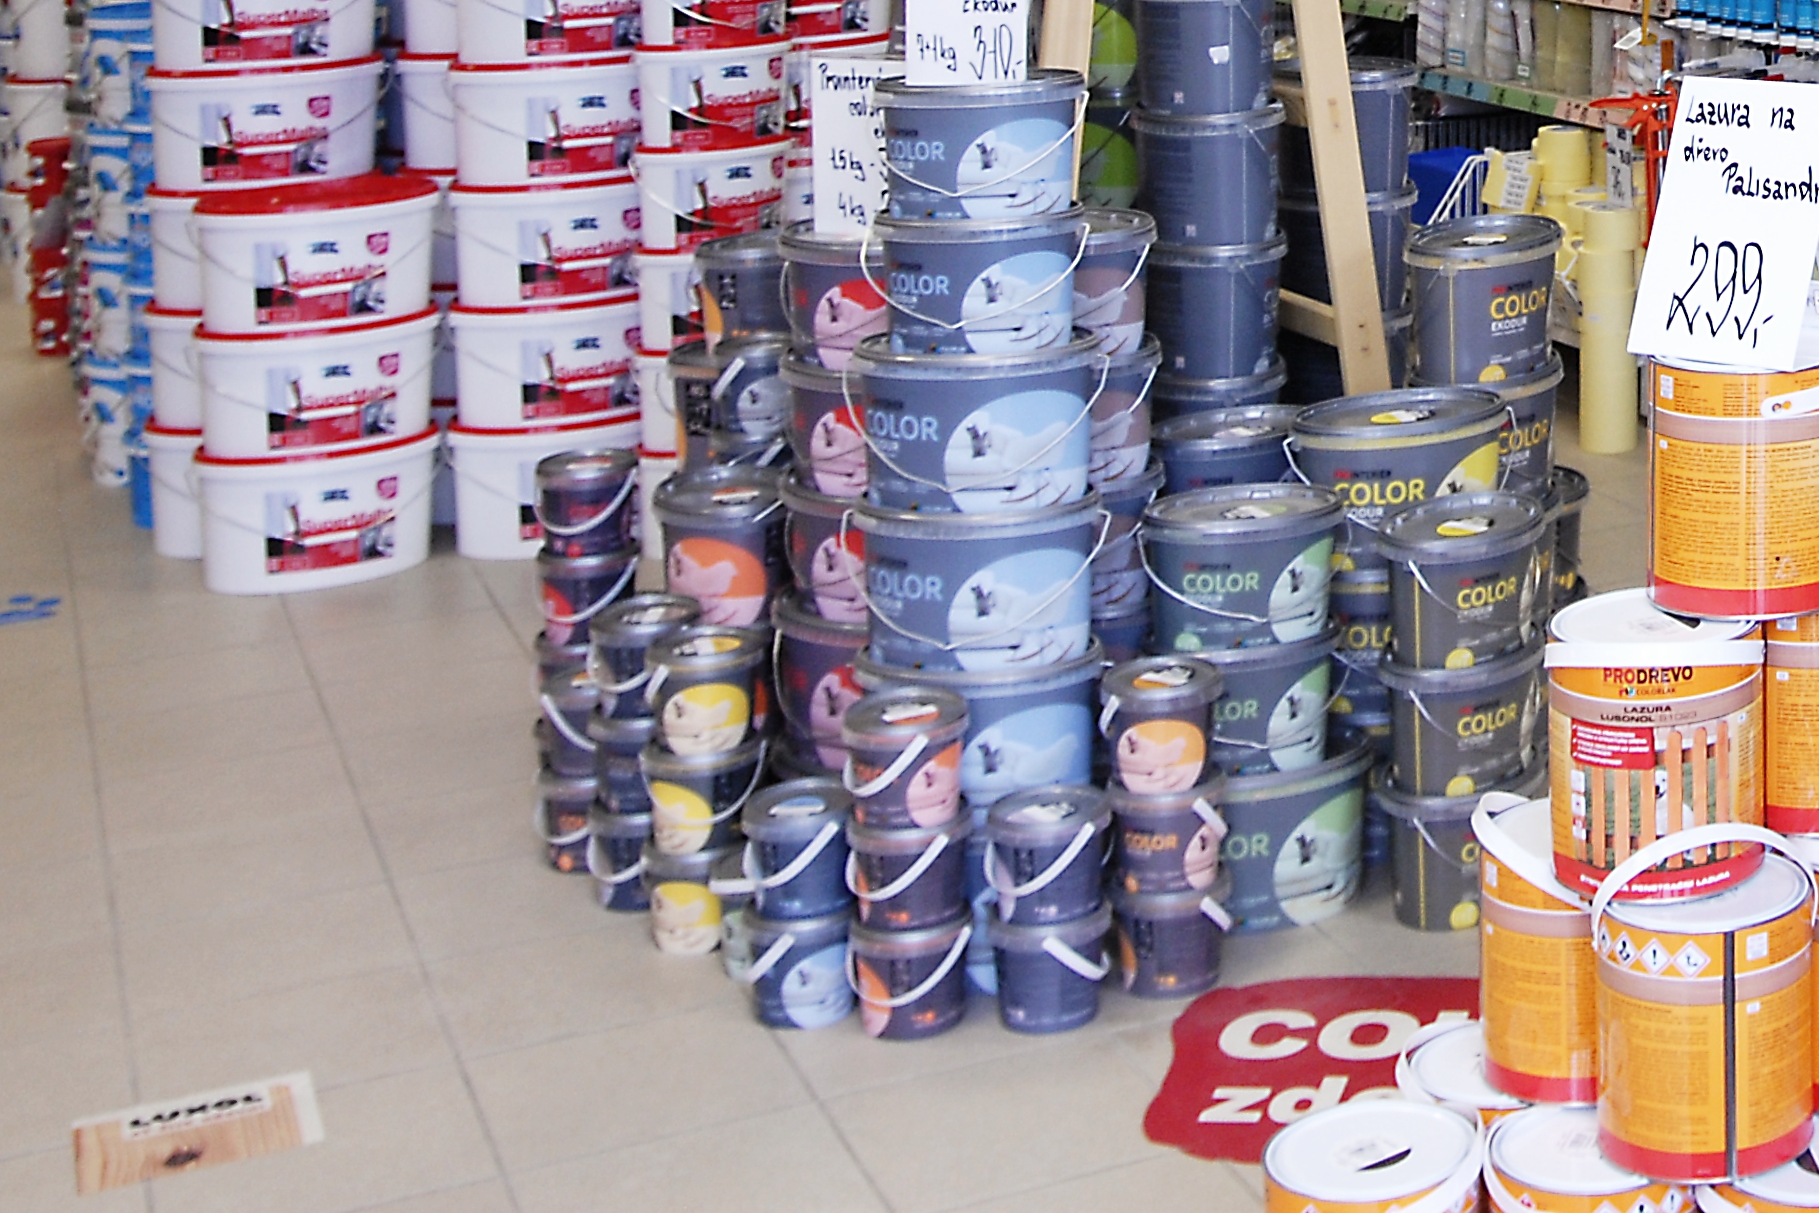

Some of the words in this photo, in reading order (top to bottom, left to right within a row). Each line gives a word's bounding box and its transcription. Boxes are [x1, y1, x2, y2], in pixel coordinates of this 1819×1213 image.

[1685, 93, 1751, 126] Lazura
[1770, 103, 1795, 131] na
[1683, 133, 1730, 163] dřevo
[1491, 287, 1547, 320] COLOR
[1665, 235, 1775, 349] 299,-
[1334, 479, 1425, 507] COLOR
[1183, 572, 1259, 594] COLOR
[1457, 576, 1517, 609] COLOR
[1636, 687, 1677, 697] COLORLAK
[1457, 703, 1517, 736] COLOR
[1599, 713, 1655, 724] LUSONOL
[1623, 704, 1673, 716] LAZURA
